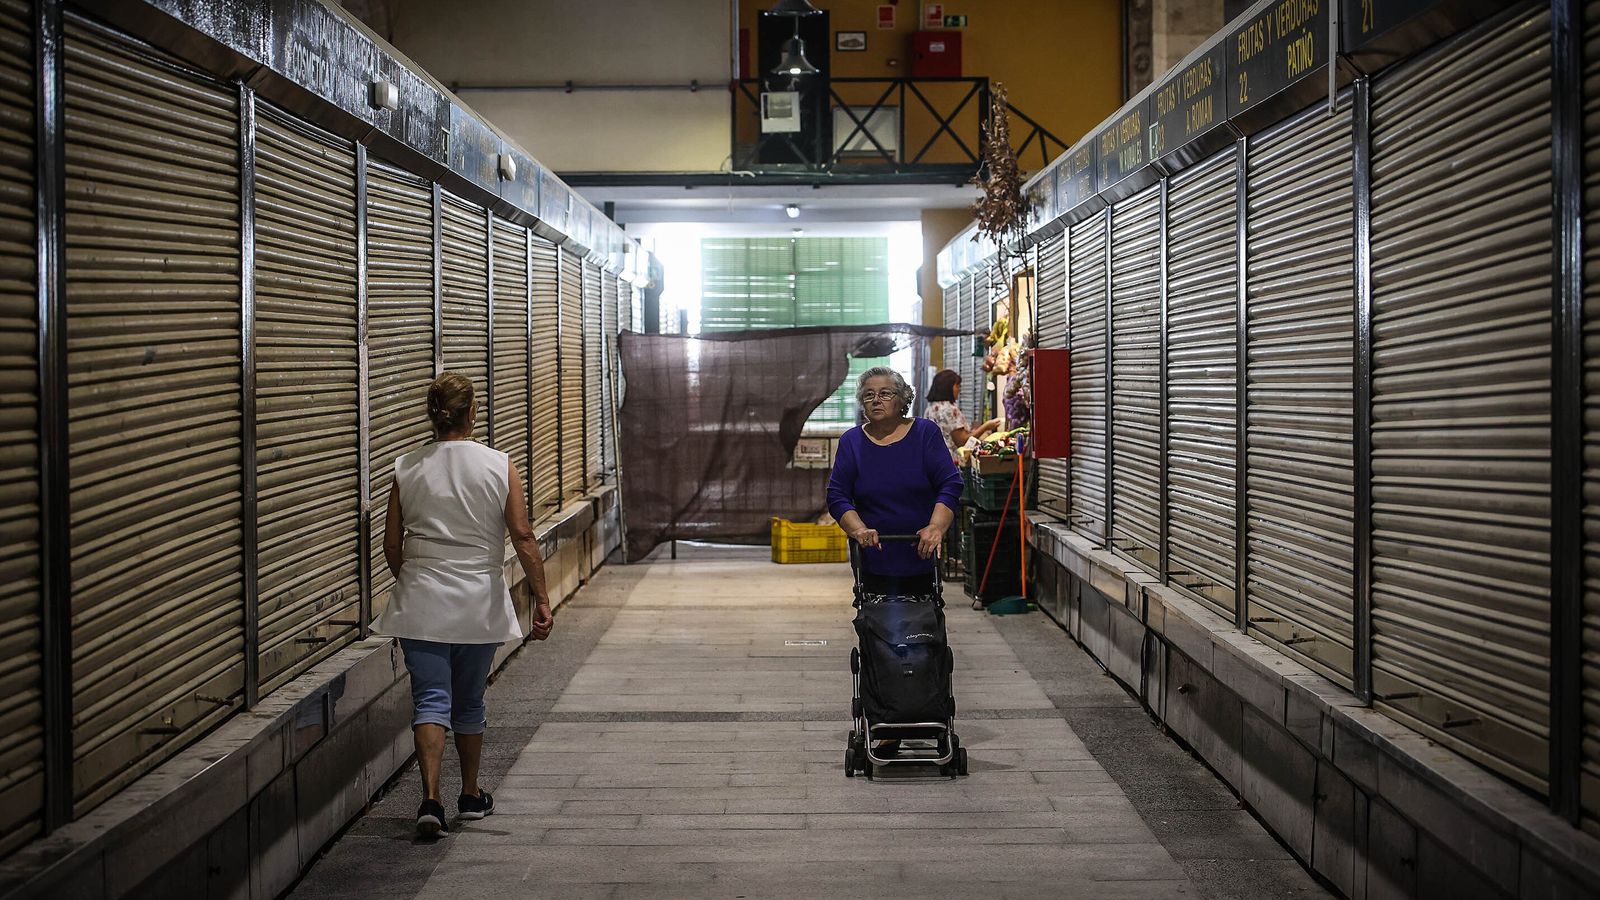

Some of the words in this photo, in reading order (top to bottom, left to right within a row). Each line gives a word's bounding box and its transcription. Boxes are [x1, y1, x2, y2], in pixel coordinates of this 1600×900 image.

[1238, 20, 1263, 64] FRUTAS
[1266, 12, 1272, 45] Y
[1361, 0, 1374, 32] 21
[1287, 28, 1314, 79] PATIÑO
[1157, 83, 1176, 118] FRUTAS
[1177, 78, 1181, 105] Y
[1183, 57, 1212, 100] VERDURAS
[1239, 71, 1248, 103] 22
